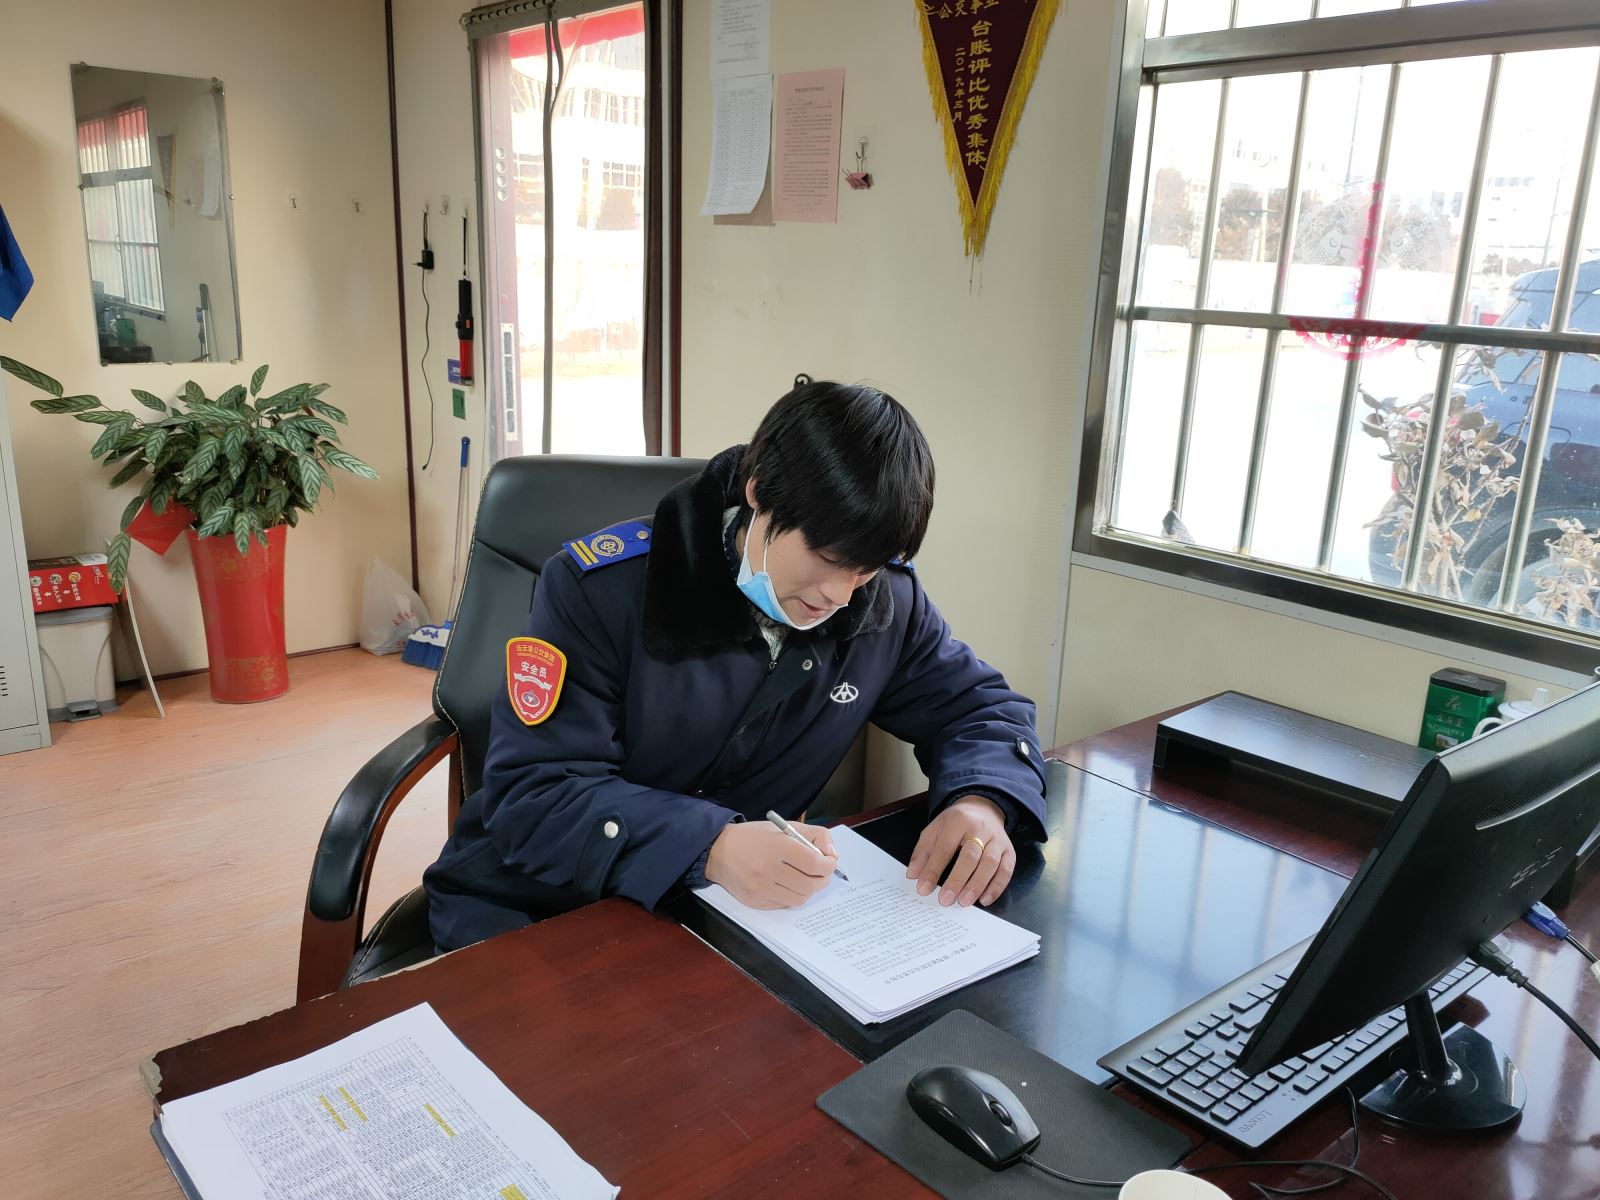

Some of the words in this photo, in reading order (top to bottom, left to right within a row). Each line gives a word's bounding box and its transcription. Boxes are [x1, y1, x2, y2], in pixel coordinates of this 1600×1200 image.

[965, 20, 993, 167] 台账评比优秀集体
[521, 661, 547, 679] 安全员
